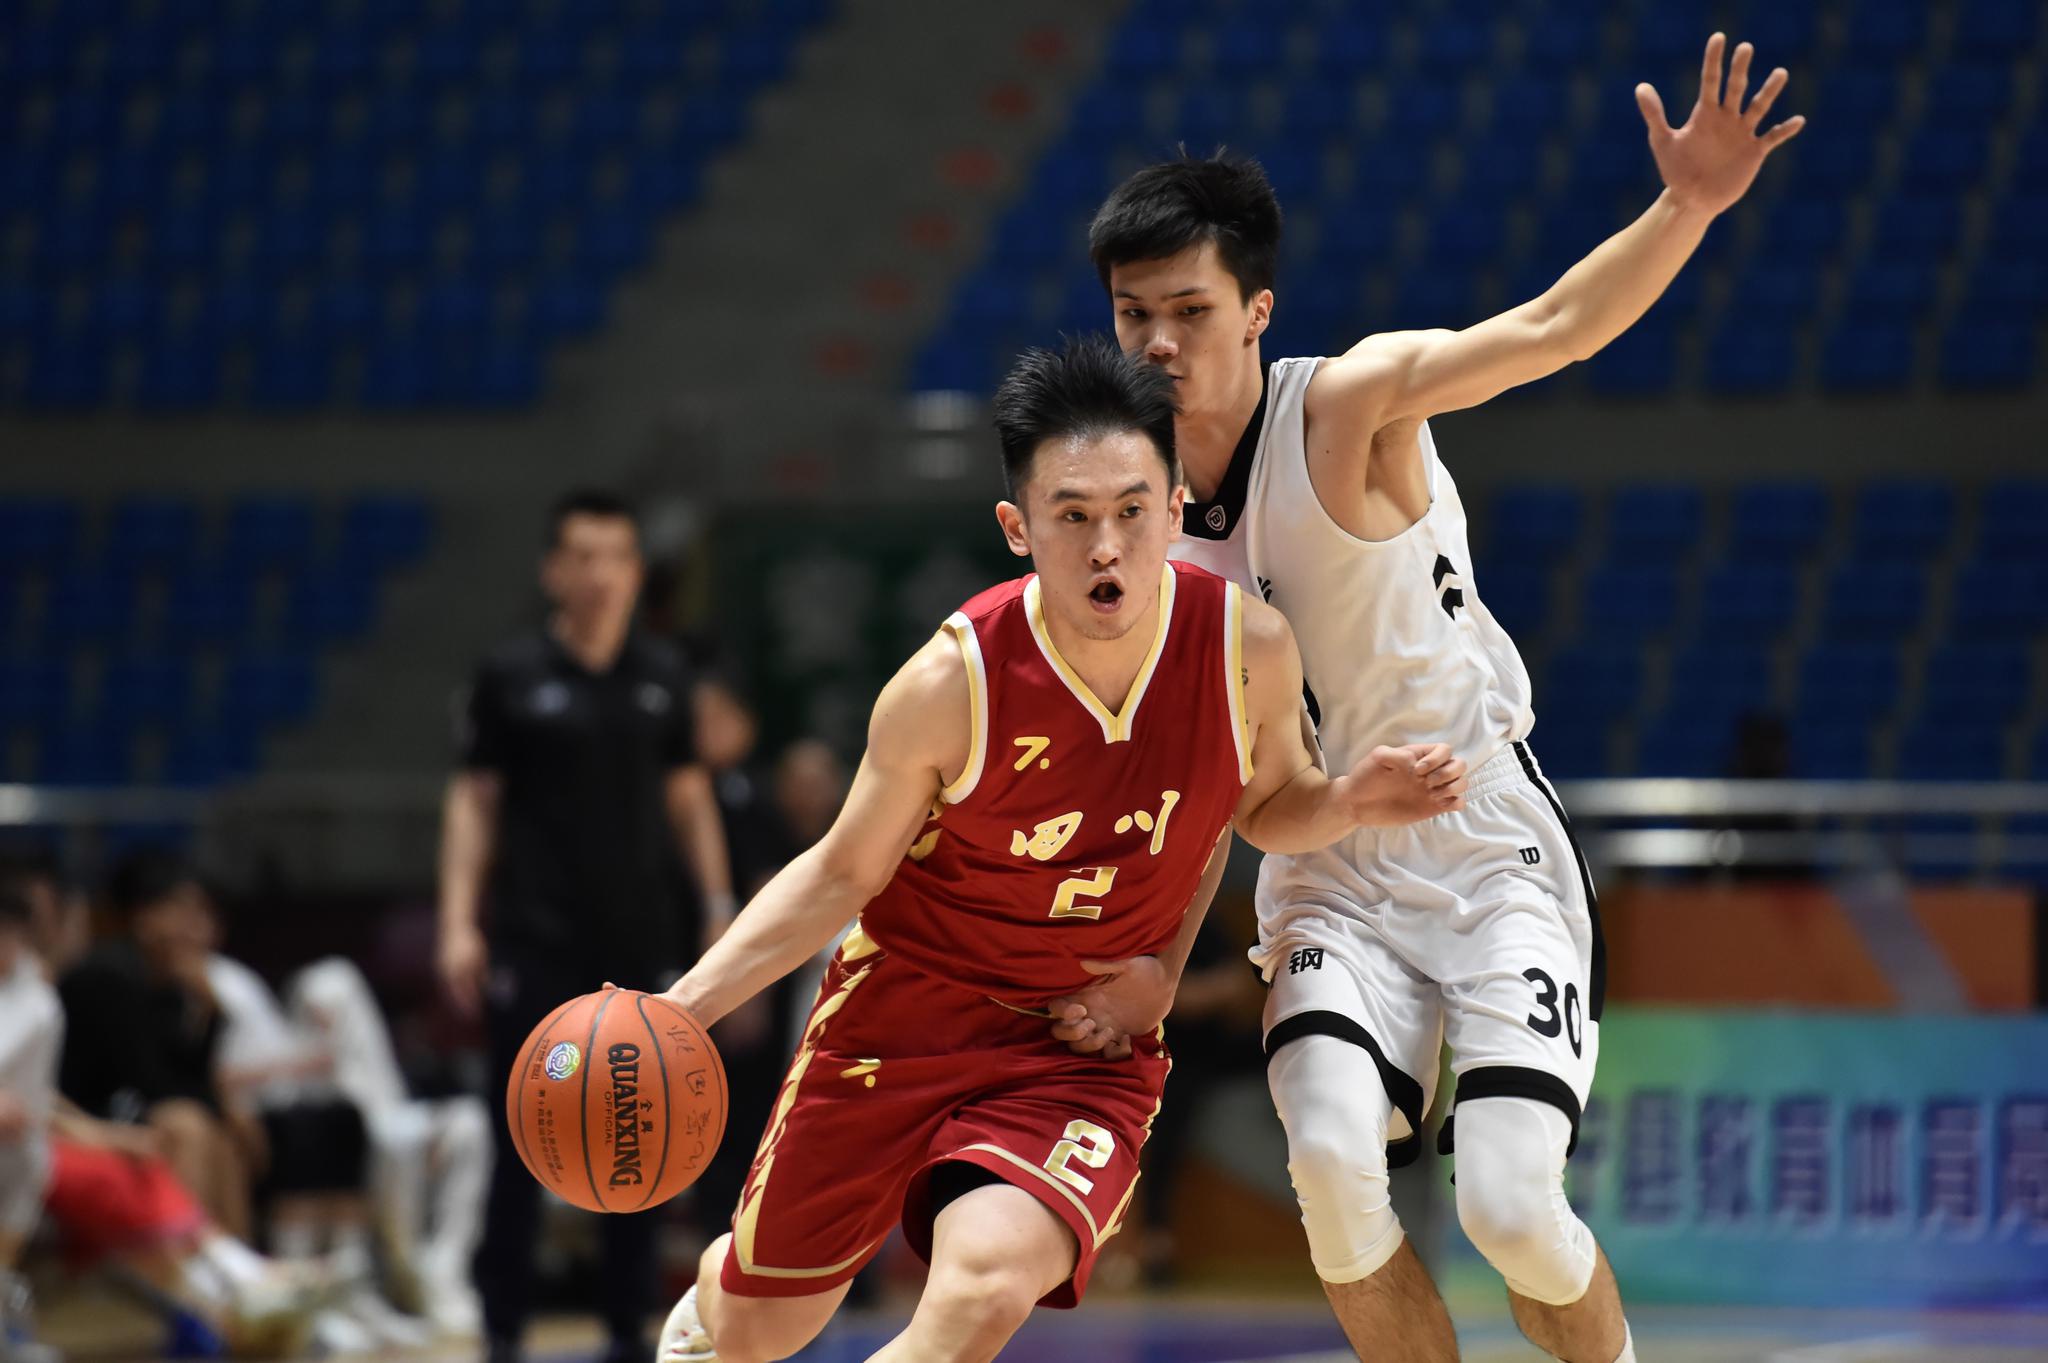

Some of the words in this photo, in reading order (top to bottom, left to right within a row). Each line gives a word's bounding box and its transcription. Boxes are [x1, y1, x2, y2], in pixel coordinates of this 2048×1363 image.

[1010, 789, 1180, 861] 四川
[1048, 866, 1118, 920] 2
[1289, 947, 1325, 976] 钢
[1522, 967, 1582, 1060] 30
[604, 1090, 614, 1146] OFFICIAL
[607, 1042, 643, 1187] QUANXING
[1043, 1118, 1116, 1197] 2
